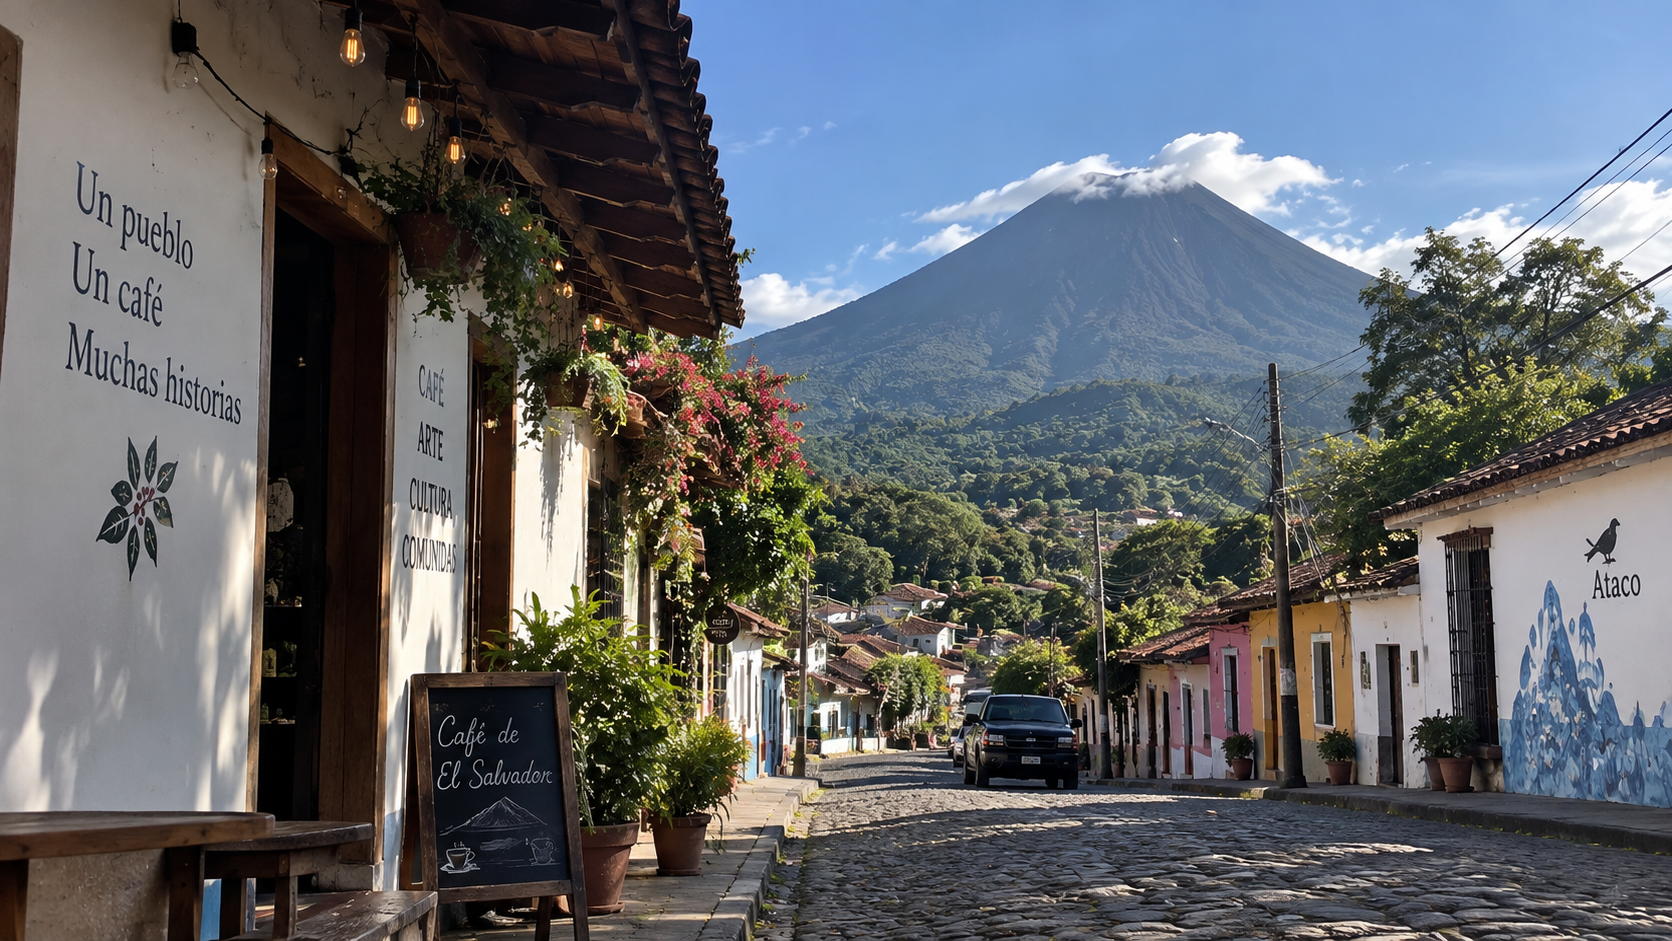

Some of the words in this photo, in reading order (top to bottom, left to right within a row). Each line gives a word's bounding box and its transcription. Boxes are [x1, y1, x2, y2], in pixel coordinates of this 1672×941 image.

[76, 161, 113, 228] Un
[120, 204, 193, 270] pueblo
[72, 241, 110, 305] Un
[118, 276, 163, 327] café
[65, 321, 159, 398] Muchas
[164, 356, 242, 425] historias
[418, 364, 445, 408] CAFÉ
[417, 420, 444, 462] ARTE
[409, 477, 453, 520] CULTURA
[402, 533, 457, 574] COMUNIDAS
[1592, 569, 1641, 599] Ataco
[437, 714, 487, 758] Café
[497, 716, 520, 744] de
[437, 759, 462, 790] El
[468, 758, 553, 790] Salvador
